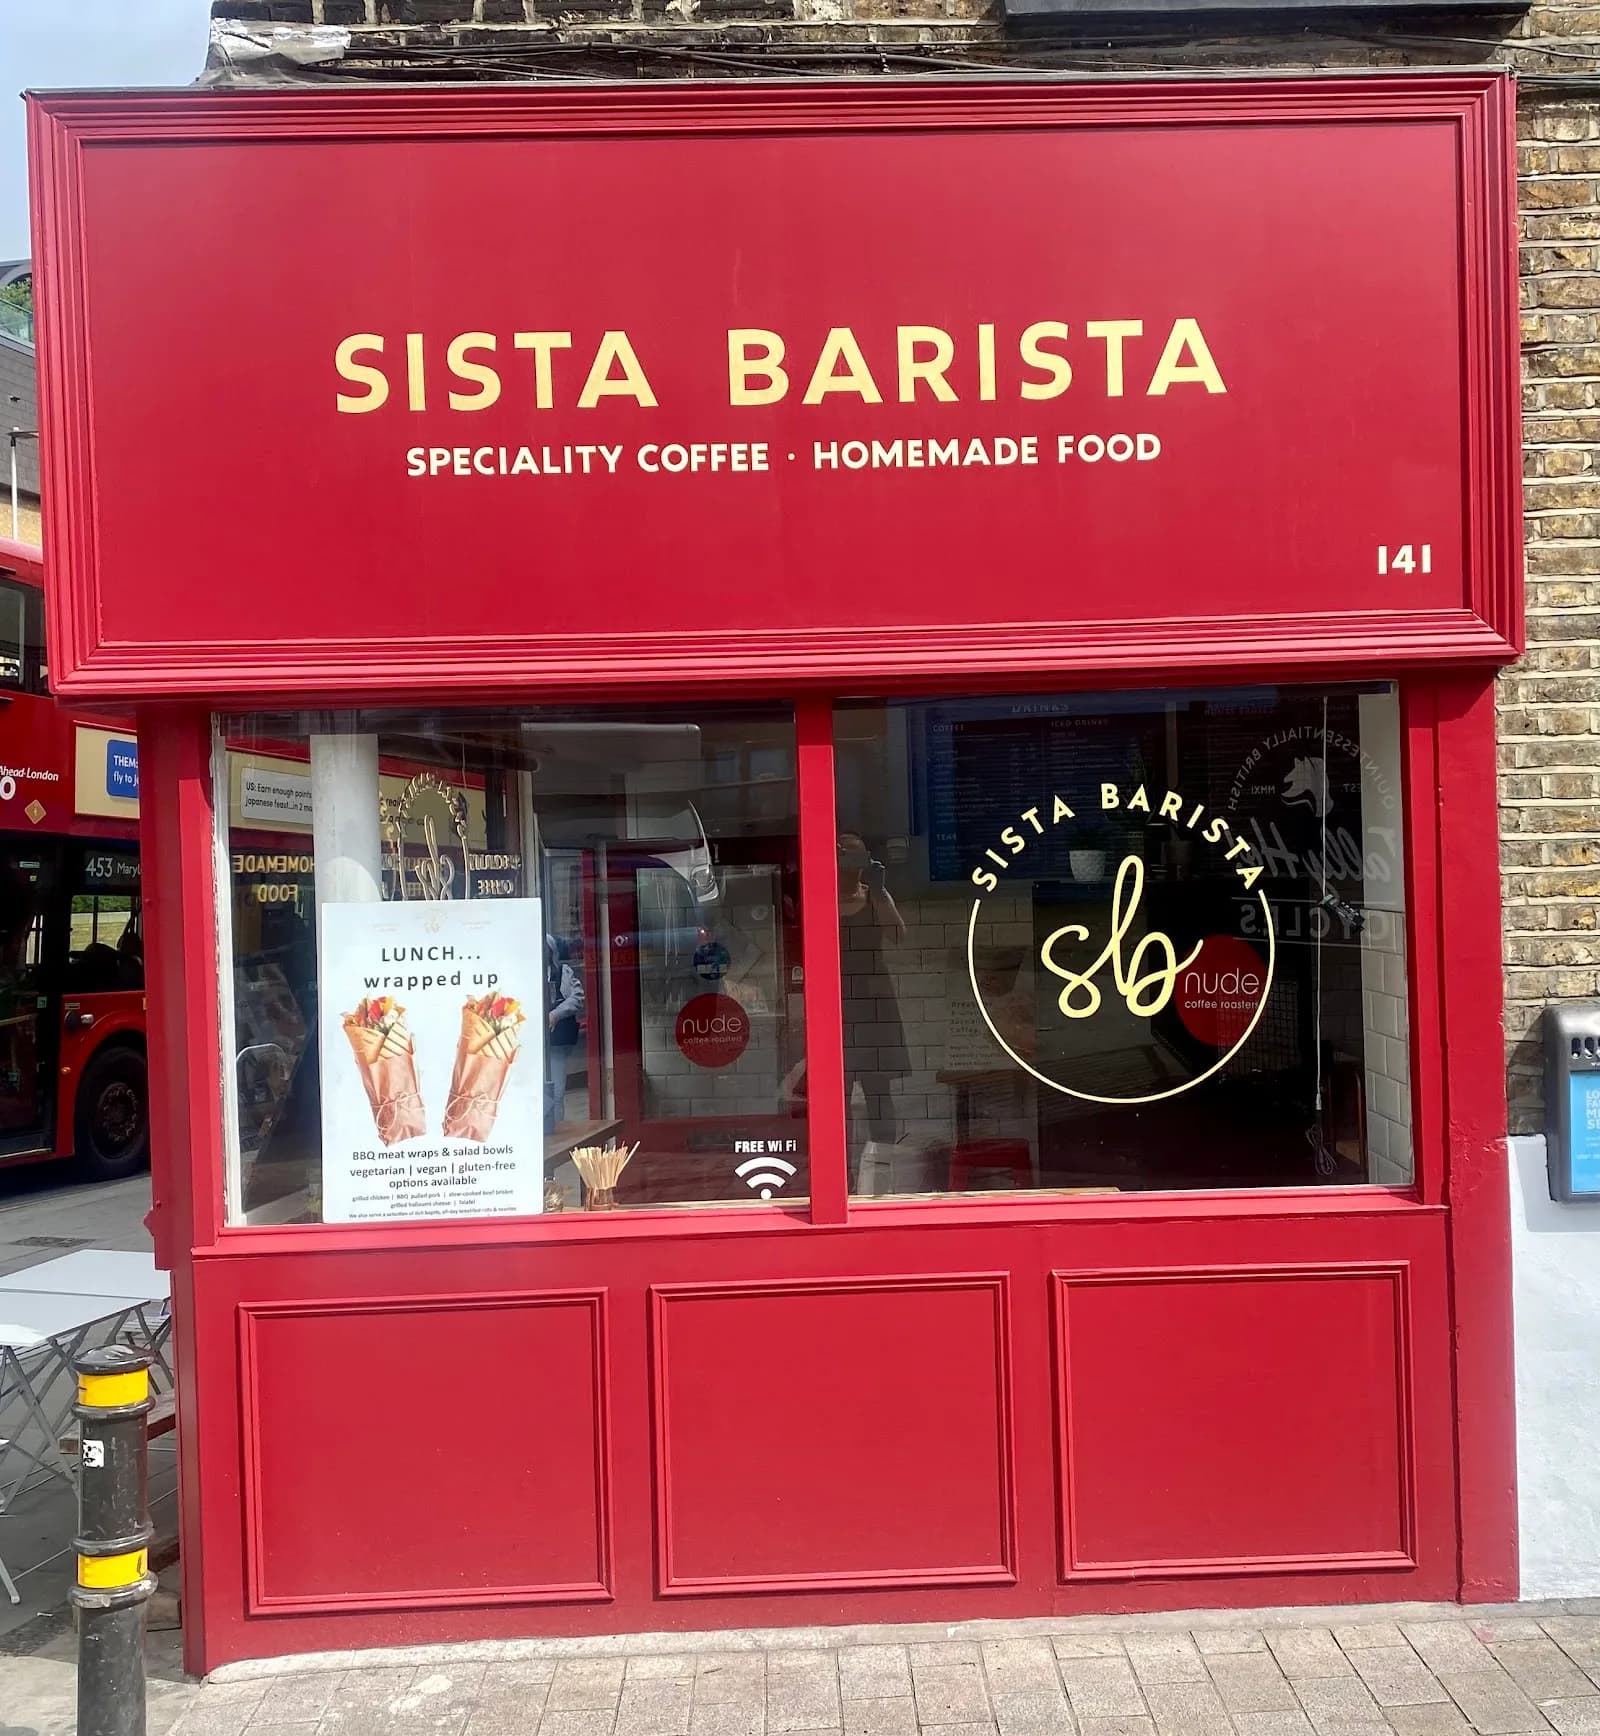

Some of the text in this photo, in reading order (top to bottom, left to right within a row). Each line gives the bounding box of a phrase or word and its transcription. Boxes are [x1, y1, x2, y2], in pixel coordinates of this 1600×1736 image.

[335, 318, 1228, 414] SISTA BARISTA
[407, 433, 1162, 477] SPECIALITY COFFEE HOMEMADE FOOD
[1377, 543, 1433, 575] 141
[114, 755, 138, 769] THEM:
[114, 771, 124, 785] fly
[125, 774, 134, 784] to
[971, 795, 1076, 893] SISTA
[1101, 783, 1265, 890] BARISTA
[85, 857, 113, 878] 453
[382, 946, 480, 962] LUNCH...
[364, 970, 498, 991] wrapped up
[1185, 967, 1260, 995] nude
[1184, 999, 1259, 1009] coffee roasters
[682, 1013, 742, 1035] nude
[352, 1144, 514, 1161] BBQ meat wraps & salad bowls
[735, 1140, 797, 1153] FREE Wi Fi
[350, 1160, 516, 1178] vegetarian vegan gluten-free
[389, 1175, 477, 1190] options available
